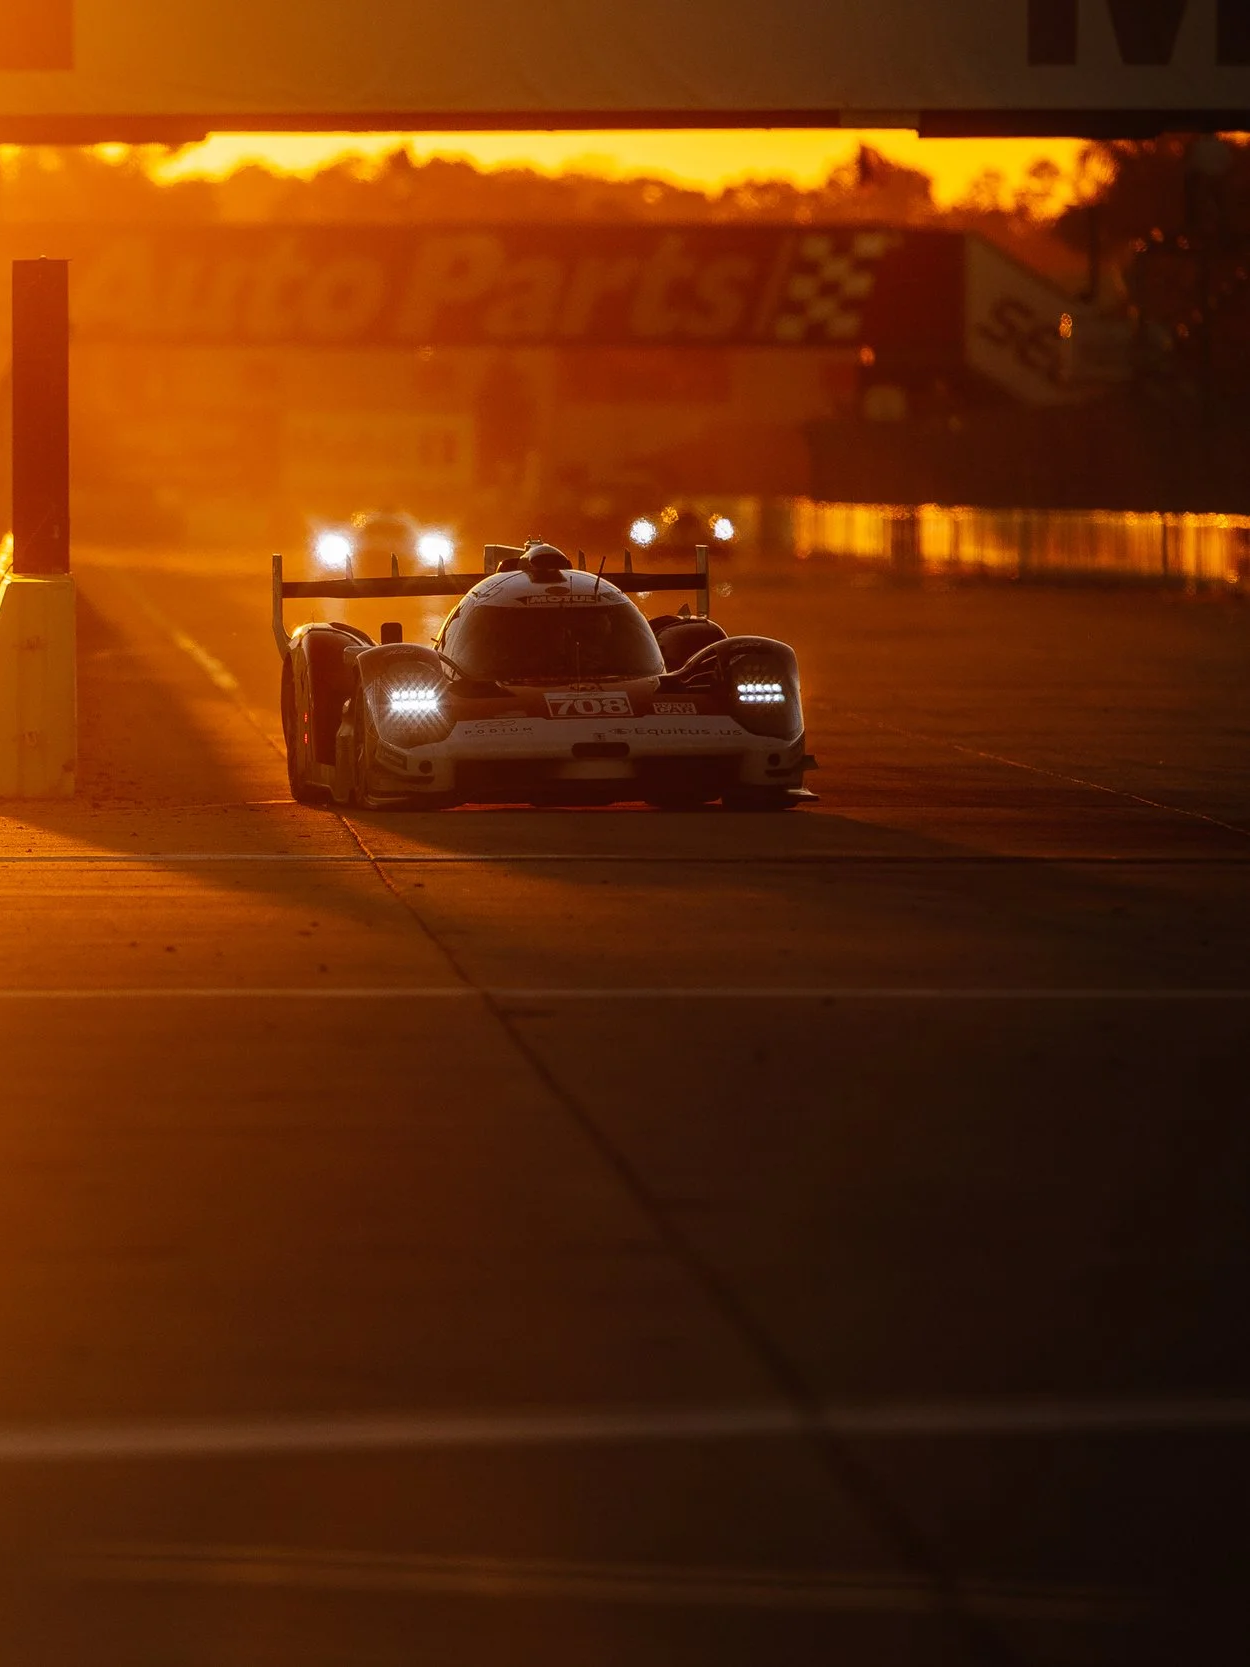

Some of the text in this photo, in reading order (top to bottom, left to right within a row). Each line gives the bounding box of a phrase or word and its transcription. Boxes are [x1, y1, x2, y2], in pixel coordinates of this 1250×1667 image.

[70, 236, 384, 338] Auto
[396, 233, 752, 338] Parts
[550, 698, 630, 715] 708
[464, 727, 533, 735] PODIUM
